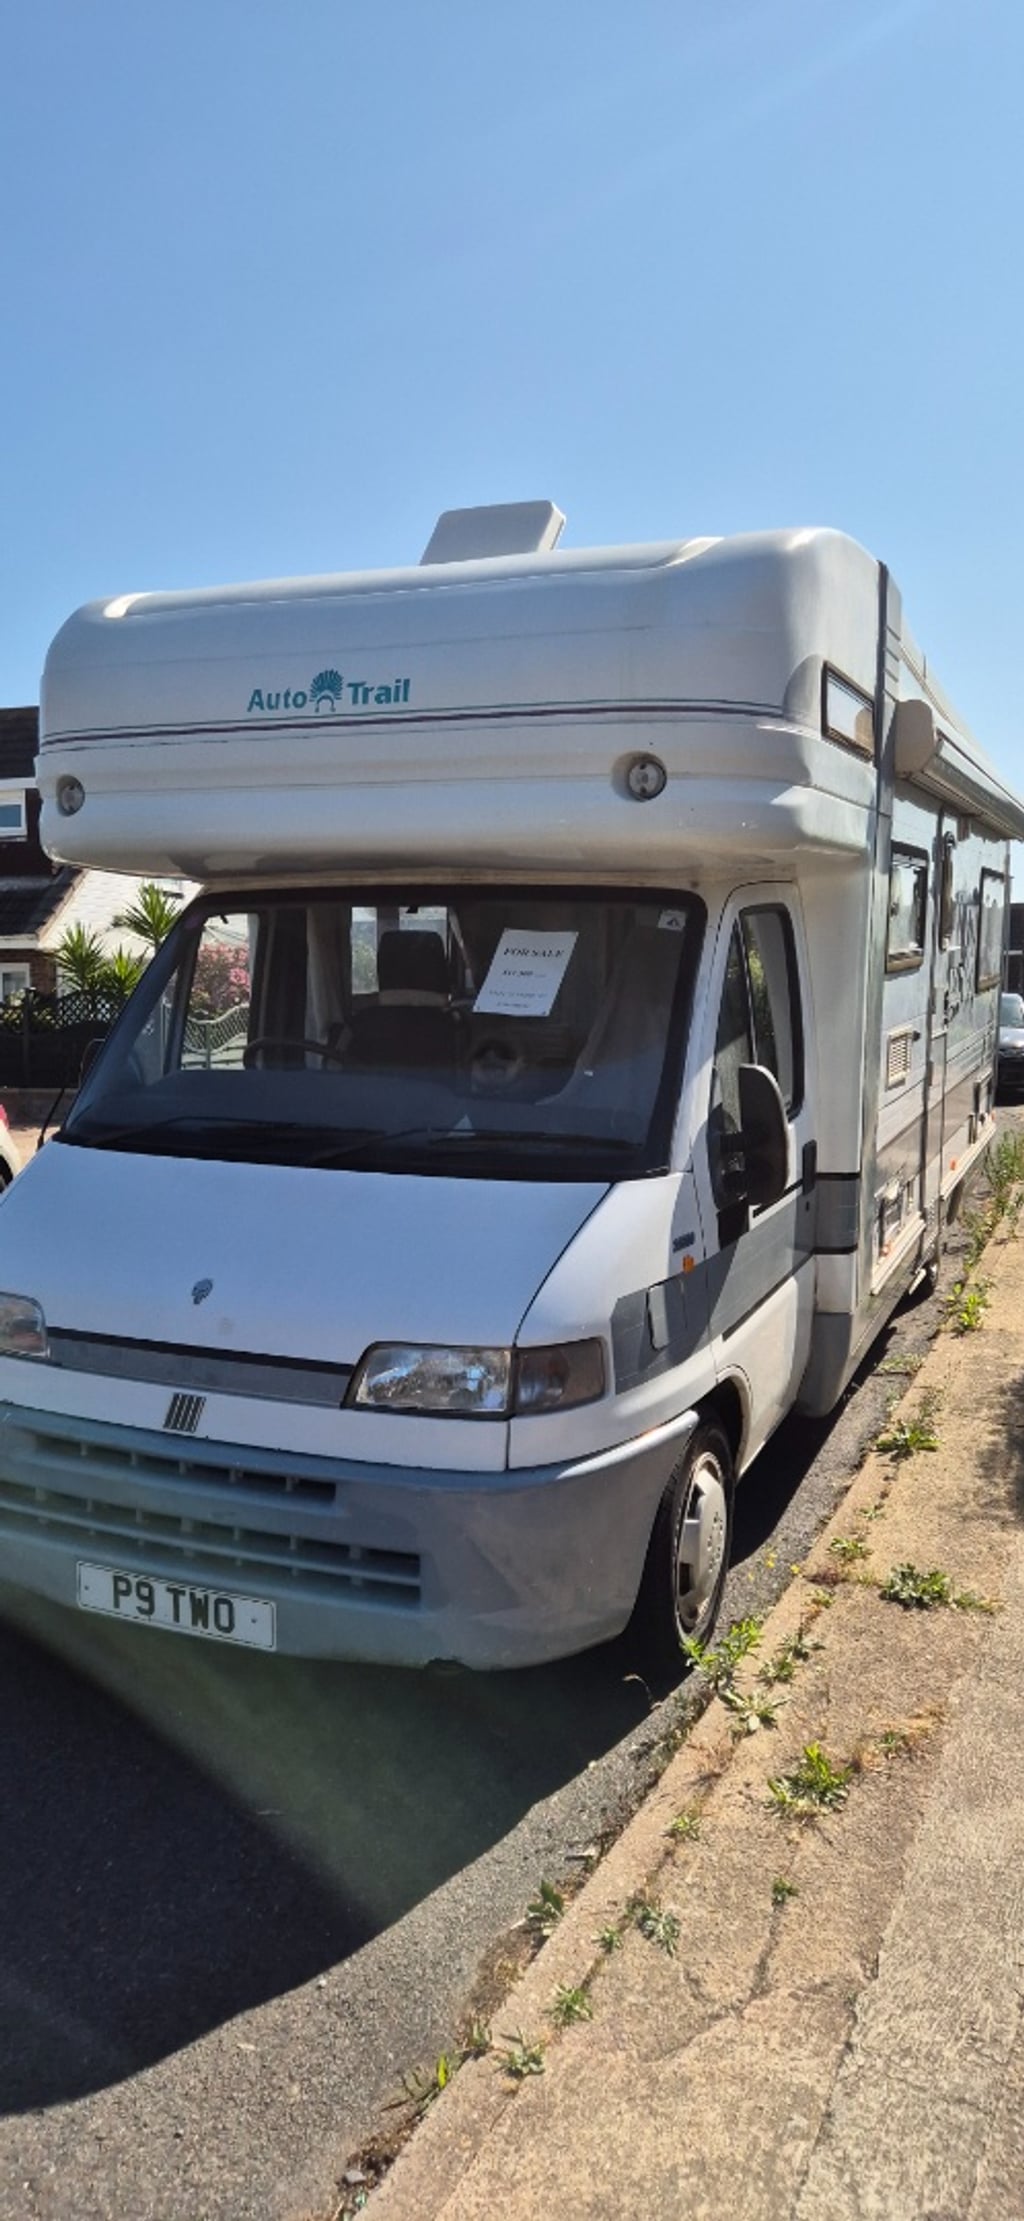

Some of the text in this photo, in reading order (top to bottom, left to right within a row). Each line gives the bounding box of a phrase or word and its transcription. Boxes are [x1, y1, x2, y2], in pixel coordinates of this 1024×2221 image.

[247, 678, 410, 712] Auto Trail
[503, 947, 564, 958] FOR SALE
[113, 1575, 235, 1633] P9 TWO
